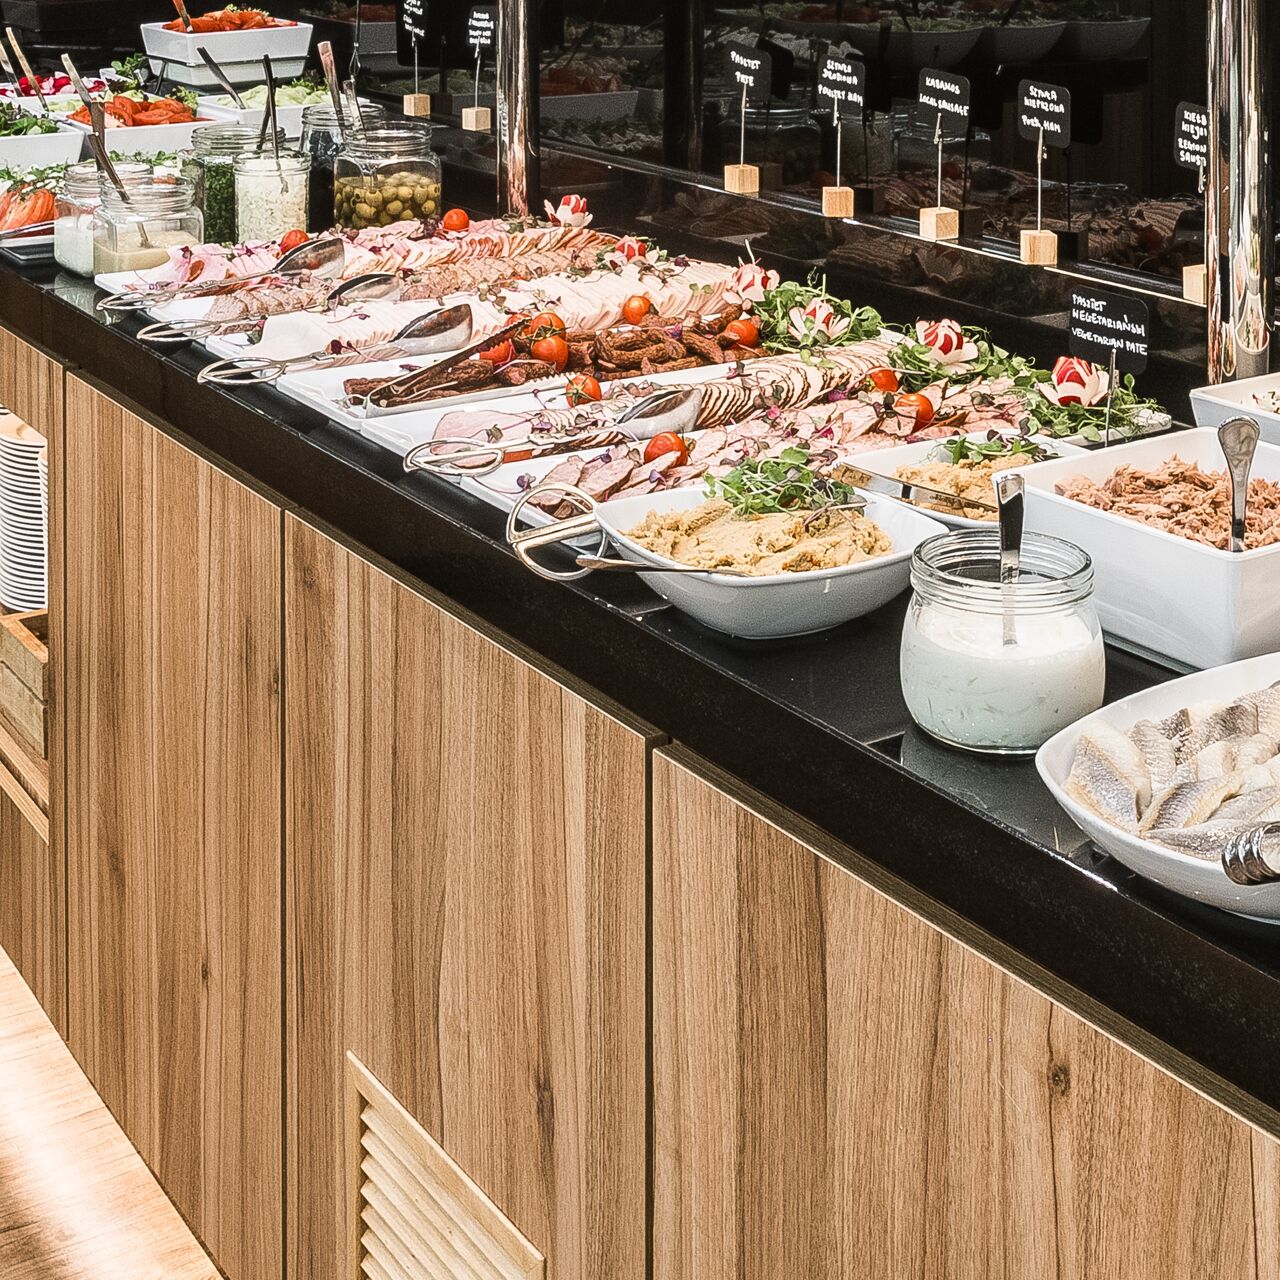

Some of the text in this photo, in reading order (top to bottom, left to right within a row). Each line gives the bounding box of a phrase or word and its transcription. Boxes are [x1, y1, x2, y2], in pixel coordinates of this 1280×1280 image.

[925, 76, 960, 95] KABANOS
[919, 93, 969, 116] LOCAL SAUSAGE
[1071, 327, 1148, 355] VEGETARIAN PATE
